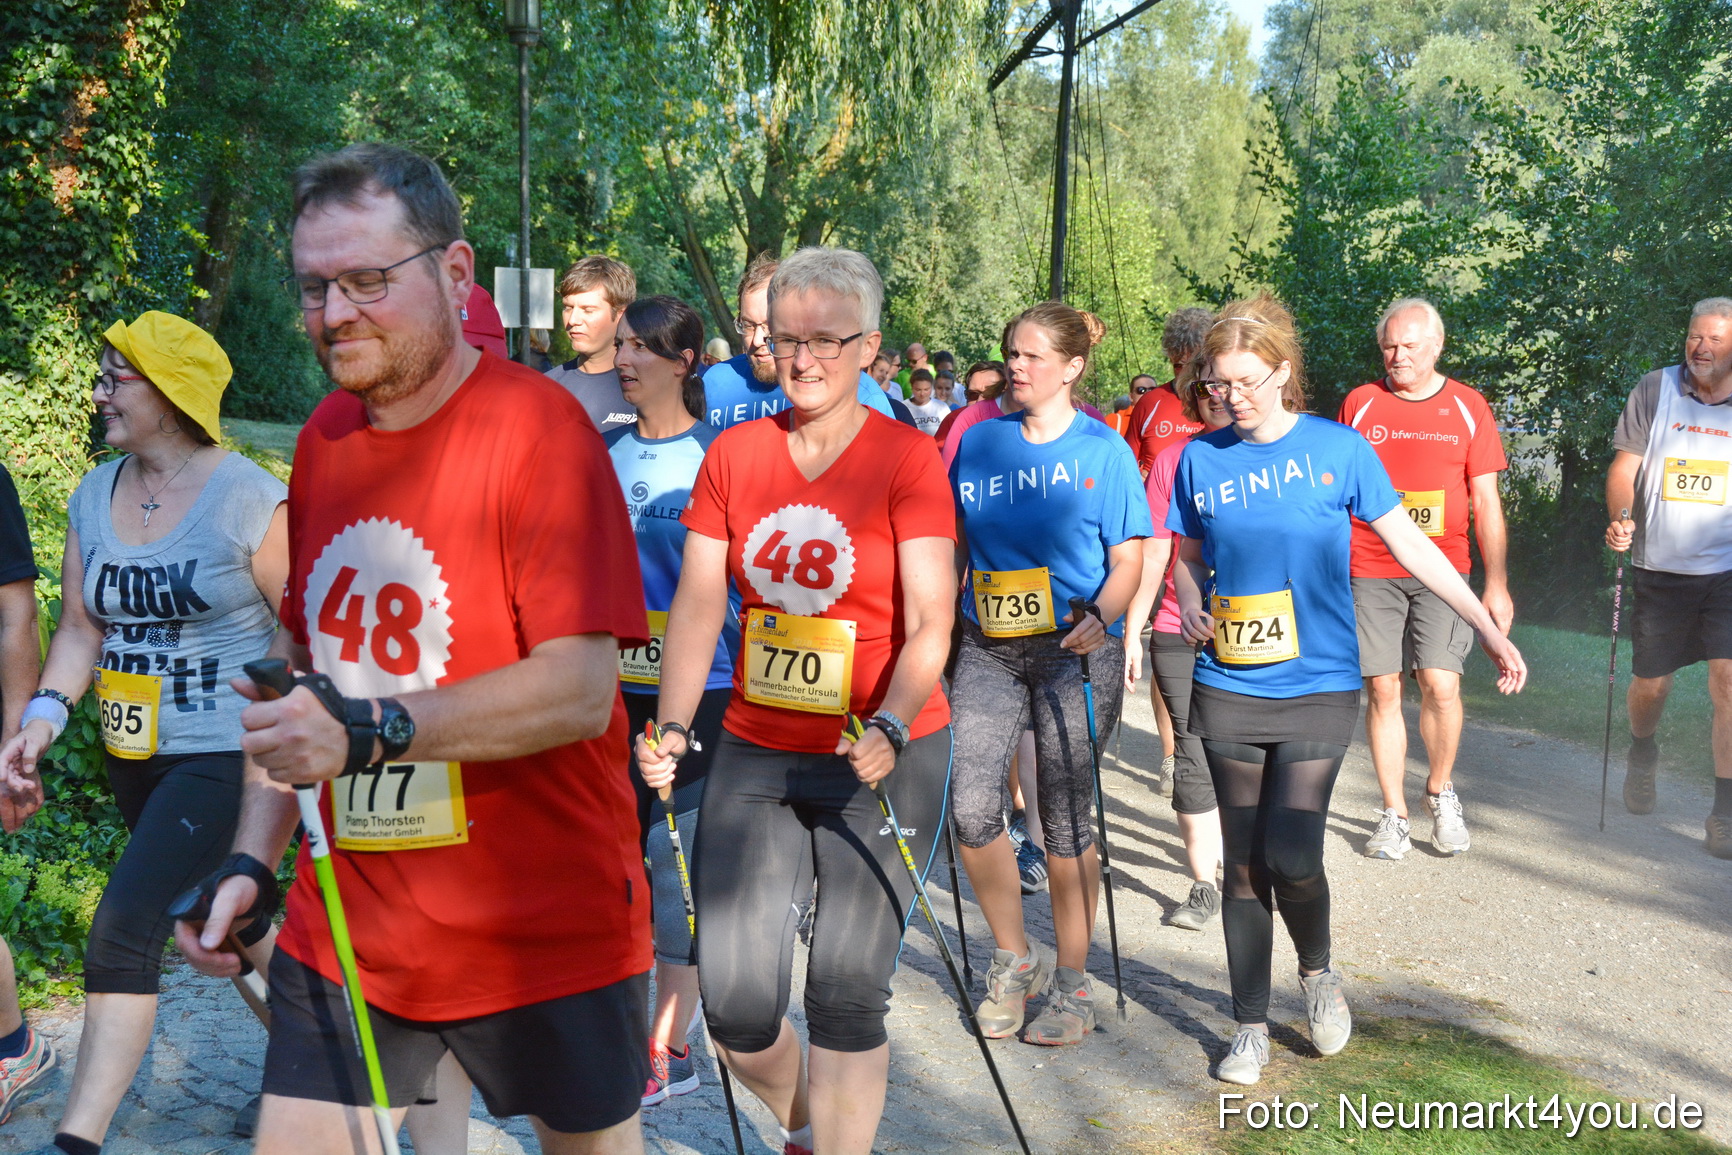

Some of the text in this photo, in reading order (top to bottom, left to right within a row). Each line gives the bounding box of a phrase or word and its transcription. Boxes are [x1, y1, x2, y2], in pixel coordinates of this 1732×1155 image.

[1391, 430, 1459, 445] bfwnürnberg
[1676, 473, 1712, 491] 870
[982, 592, 1041, 619] 1736
[1614, 584, 1622, 609] EASY
[1015, 617, 1038, 625] Carina
[1612, 611, 1620, 632] WAY
[1219, 616, 1284, 645] 1724
[1247, 644, 1274, 652] Martina
[623, 661, 648, 671] Brauner
[763, 646, 822, 685] 770
[749, 677, 838, 698] Hammerbacher Ursula
[760, 689, 820, 703] Hammerbacher GmbH
[371, 815, 425, 827] Thorsten
[394, 828, 422, 838] GmbH
[897, 838, 917, 871] LEKI
